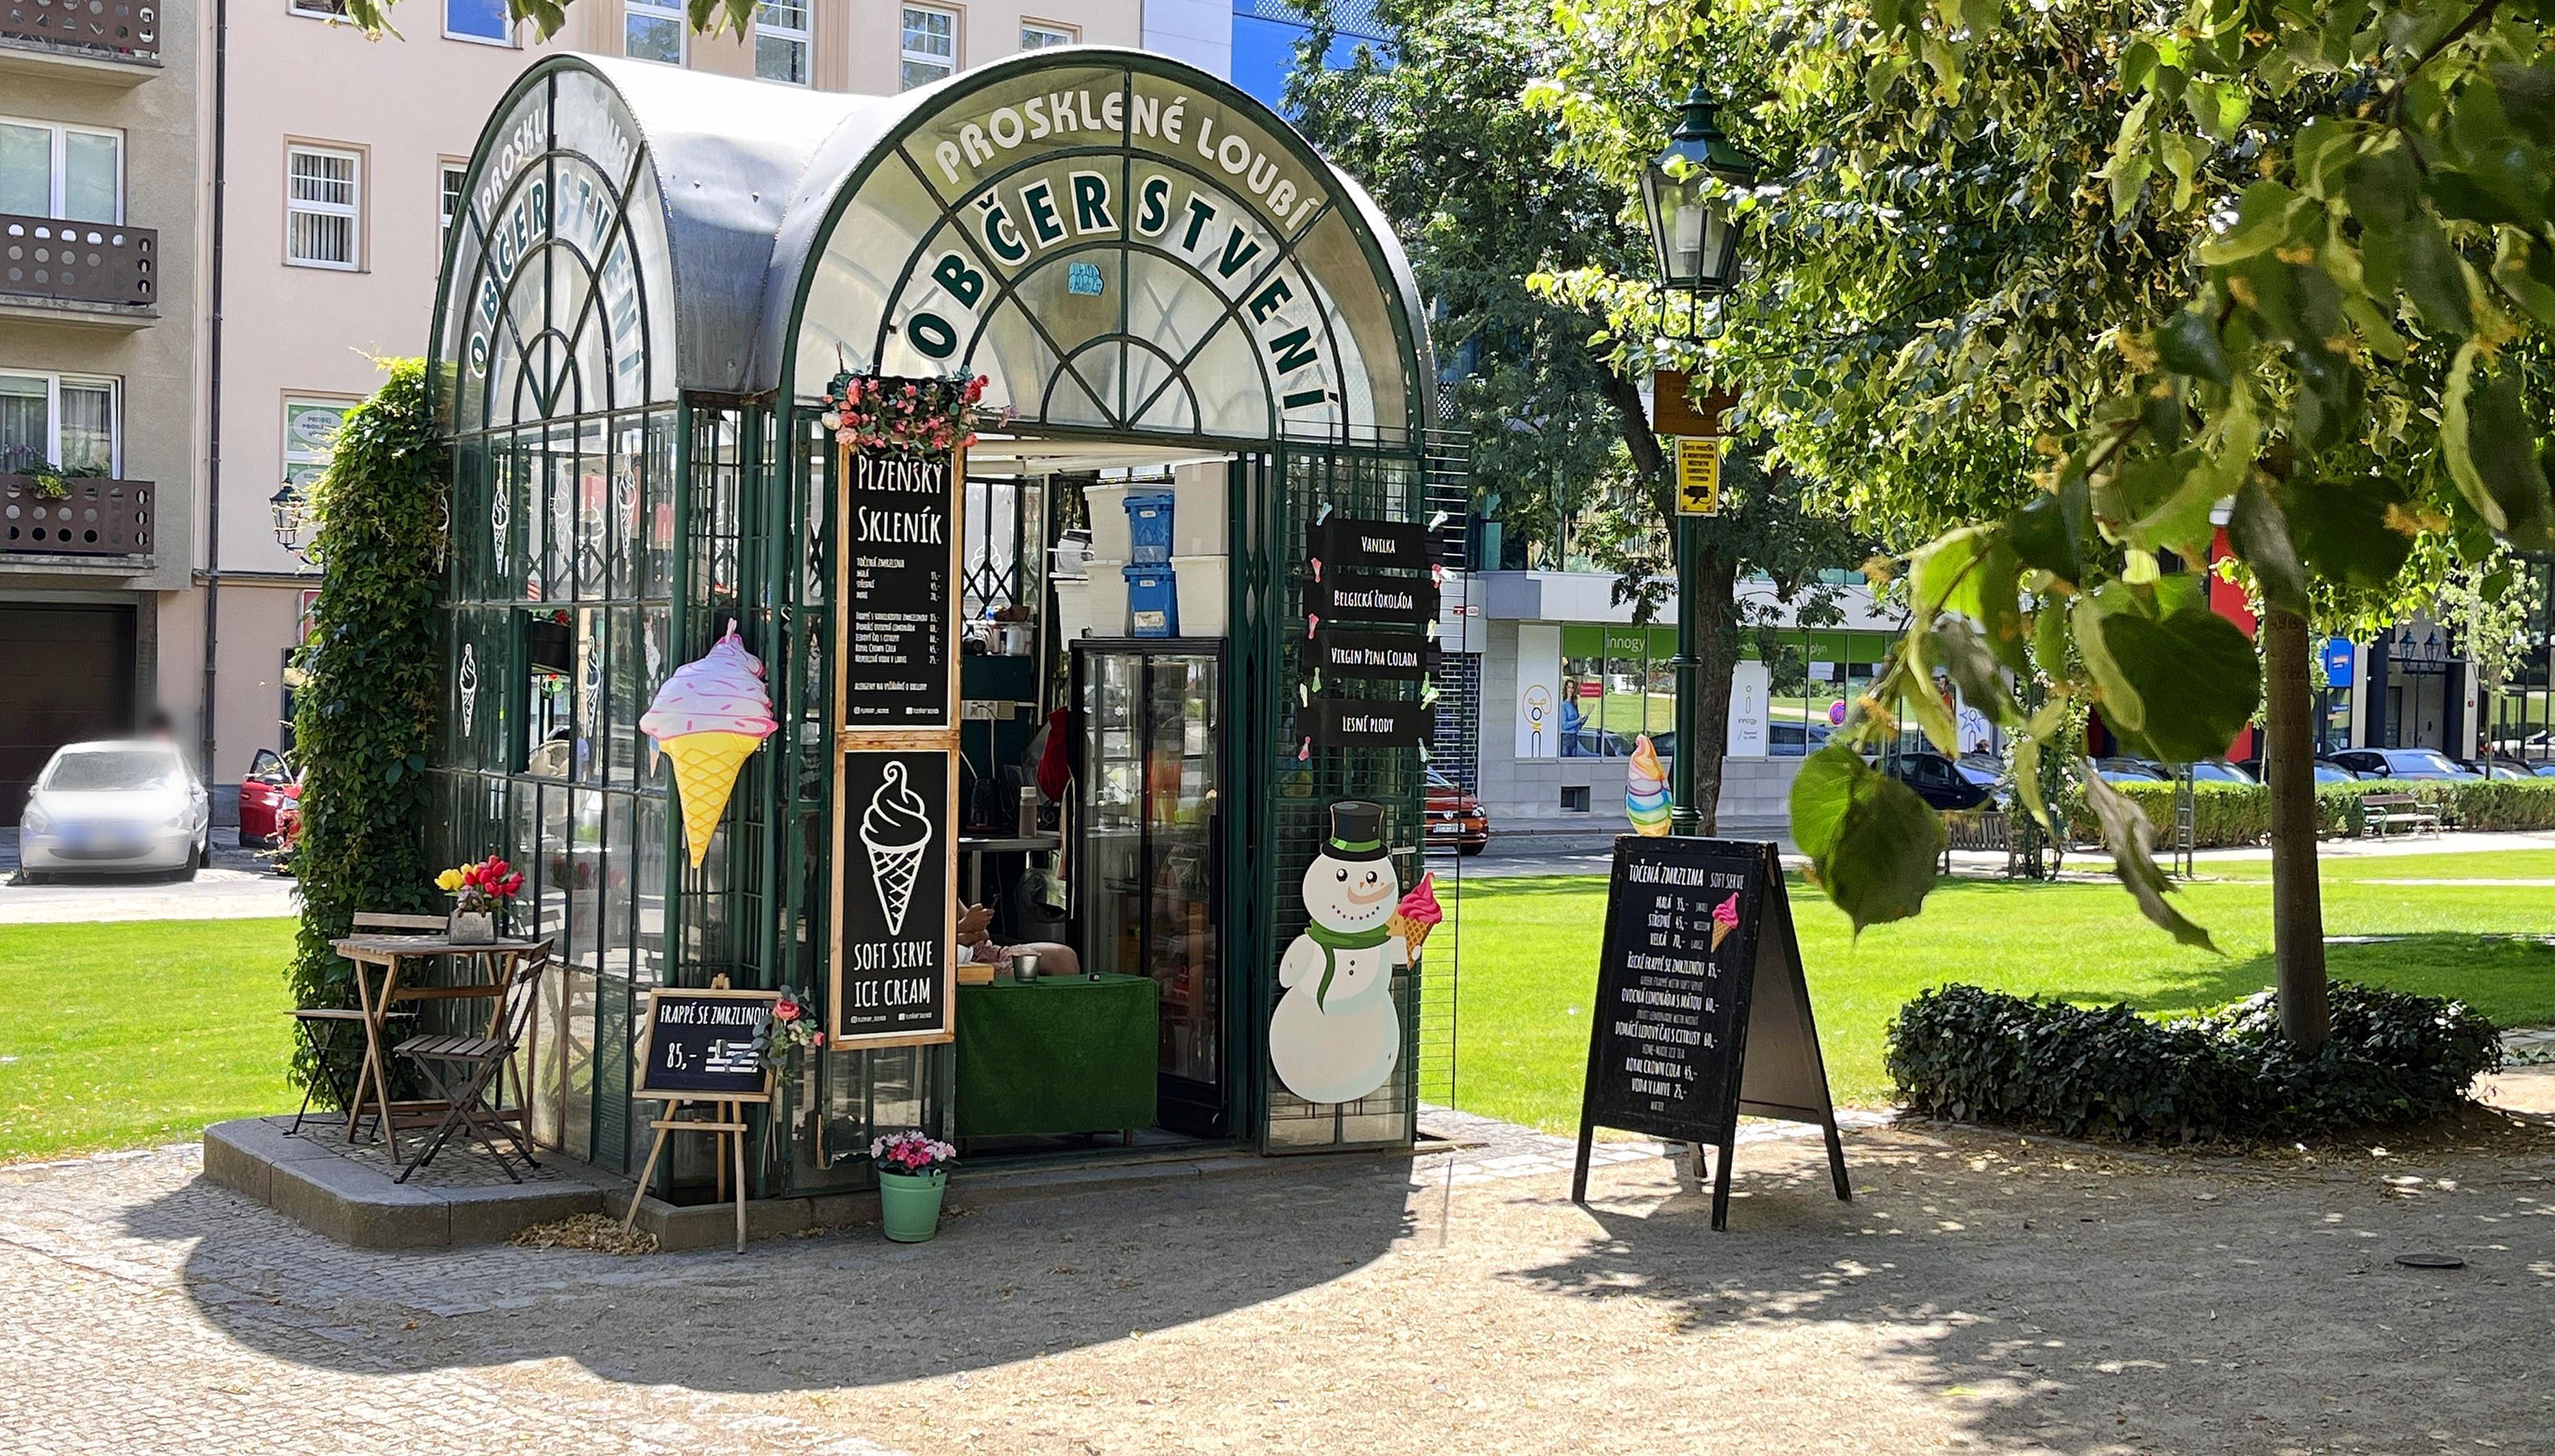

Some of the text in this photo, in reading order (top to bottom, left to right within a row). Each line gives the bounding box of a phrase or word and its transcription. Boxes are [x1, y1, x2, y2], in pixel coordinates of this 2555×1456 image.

[934, 90, 1330, 231] PROSKLENÉ LOUBÍ
[905, 170, 1339, 415] OBČERSTVENÍ
[858, 452, 943, 494] PLZEŇSKÝ
[857, 506, 942, 544] SKLENÍK
[1361, 536, 1396, 554] VANILKA
[1334, 589, 1413, 610] BELGICKÁ ČOKOLÁDA
[1606, 634, 1646, 652] innogy
[1331, 647, 1418, 667] VIRGIN PINA COLADA
[1342, 715, 1394, 733] LESNÍ PLODY
[1629, 858, 1662, 883] TOČENÁ
[1660, 866, 1704, 886] ZMRZLINA
[1709, 871, 1725, 889] SOFT
[1655, 893, 1673, 909] MALÁ
[854, 941, 933, 971] SOFT SERVE
[854, 978, 931, 1008] ICE CREAM
[660, 1001, 697, 1023] FRAPPÉ
[696, 1006, 709, 1025] SE
[667, 1042, 697, 1071] 85,-
[1643, 1059, 1665, 1076] CROWN
[1665, 1062, 1681, 1077] COLA
